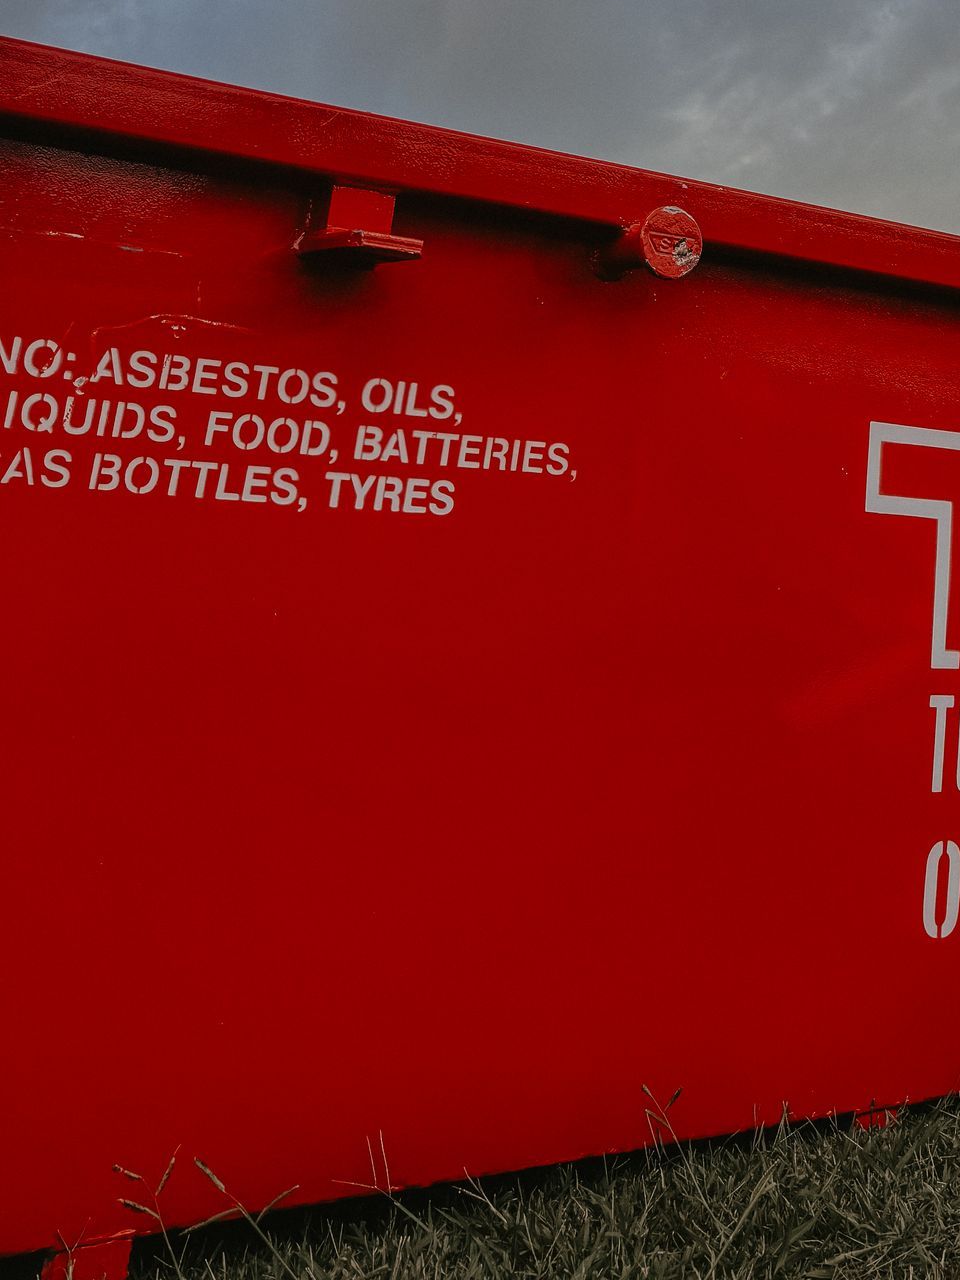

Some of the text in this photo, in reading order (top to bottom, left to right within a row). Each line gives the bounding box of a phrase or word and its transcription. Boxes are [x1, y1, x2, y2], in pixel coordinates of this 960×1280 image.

[0, 336, 463, 426] NO: ASBESTOS, OILS,
[0, 448, 456, 516] AS BOTTLES, TYRES
[4, 391, 578, 483] IQUIDS, FOOD, BATTERIES,
